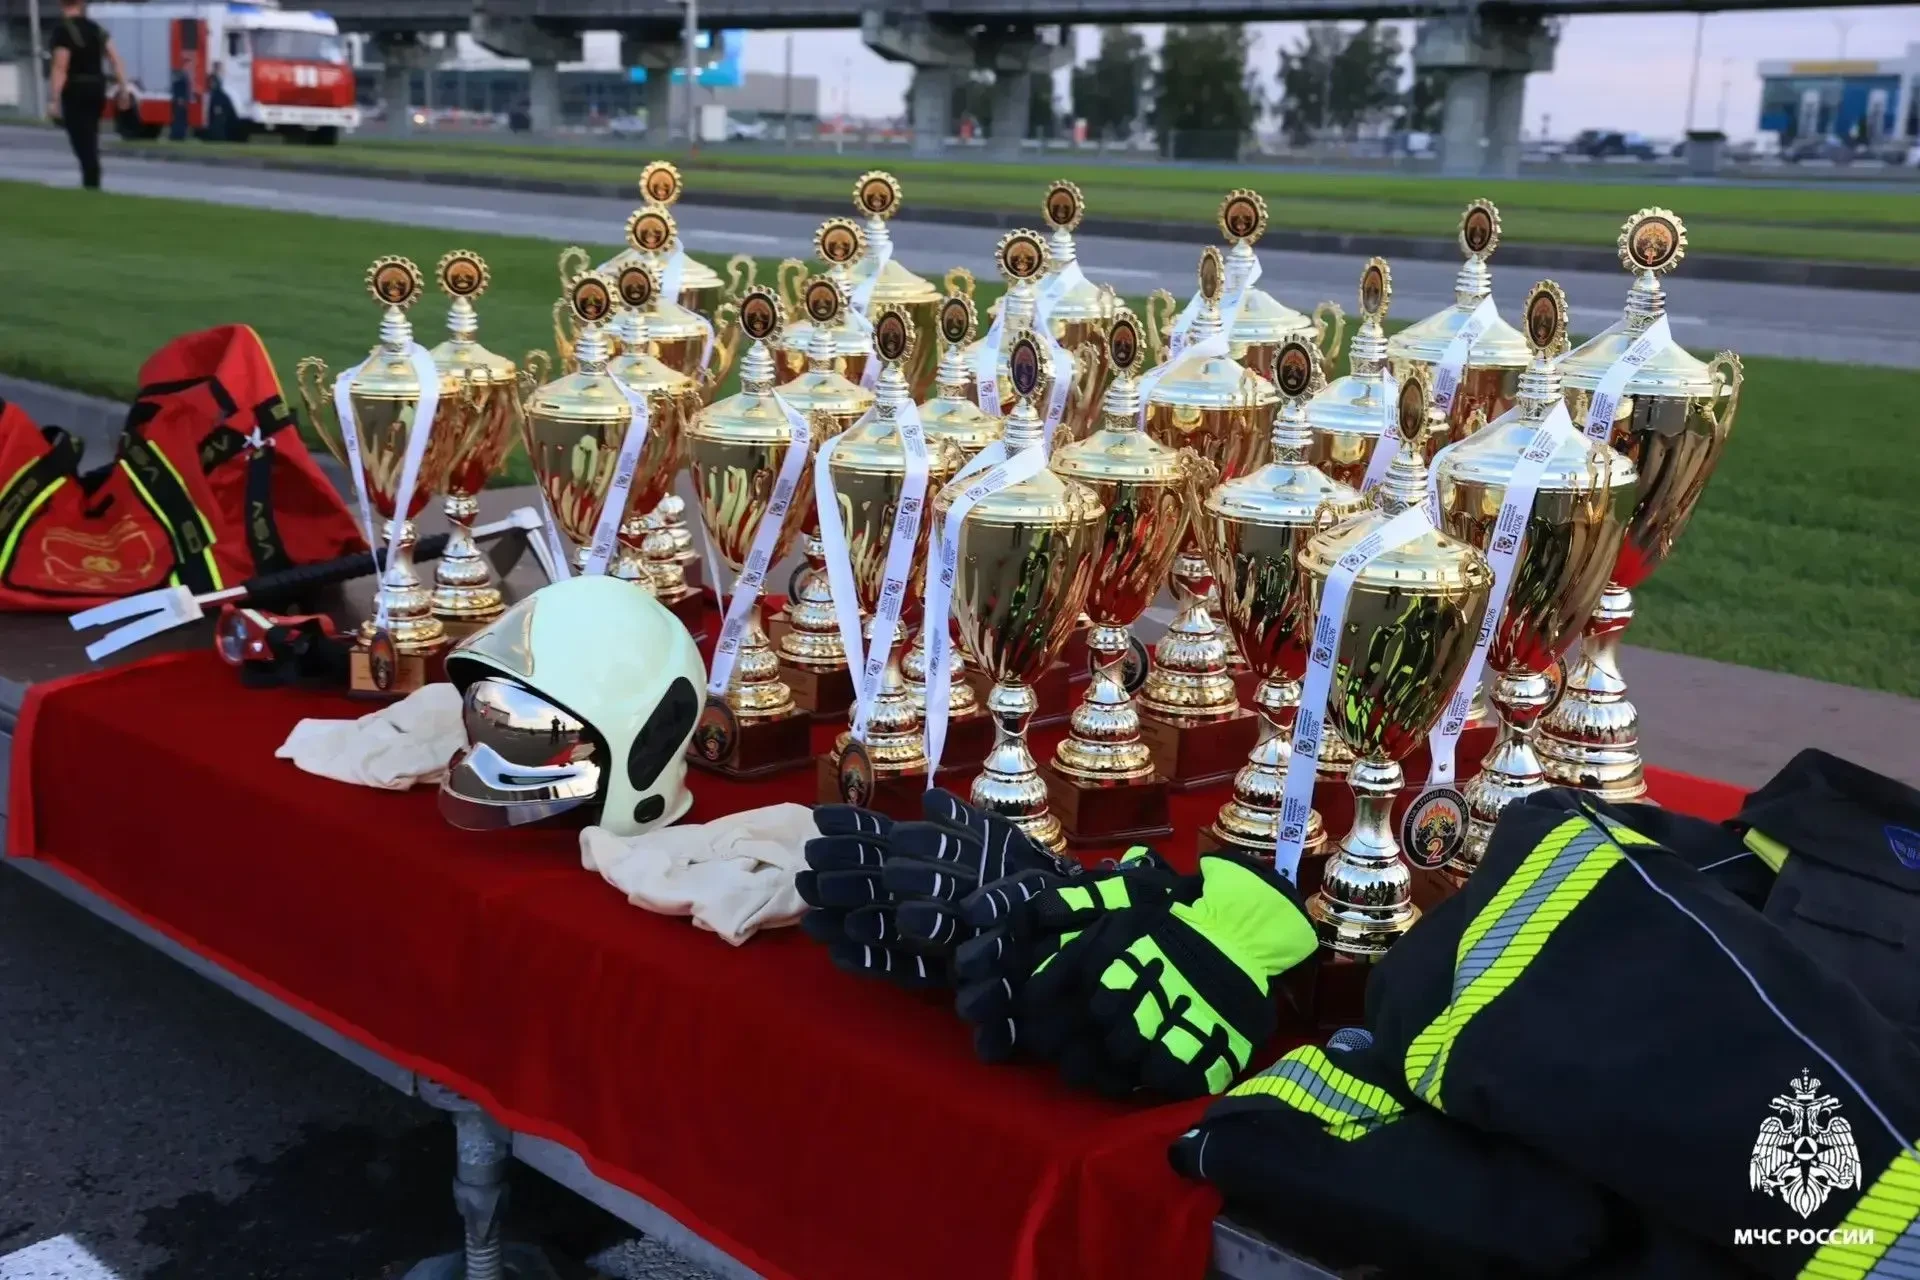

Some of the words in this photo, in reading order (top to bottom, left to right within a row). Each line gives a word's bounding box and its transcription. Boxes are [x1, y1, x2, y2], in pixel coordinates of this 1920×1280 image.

[1509, 512, 1524, 535] 2026
[1483, 606, 1497, 628] 2026
[1325, 627, 1337, 649] 2026
[1456, 696, 1470, 718] 2026
[1308, 719, 1321, 740] 2026
[1295, 803, 1307, 823] 2026
[1426, 838, 1443, 864] 2
